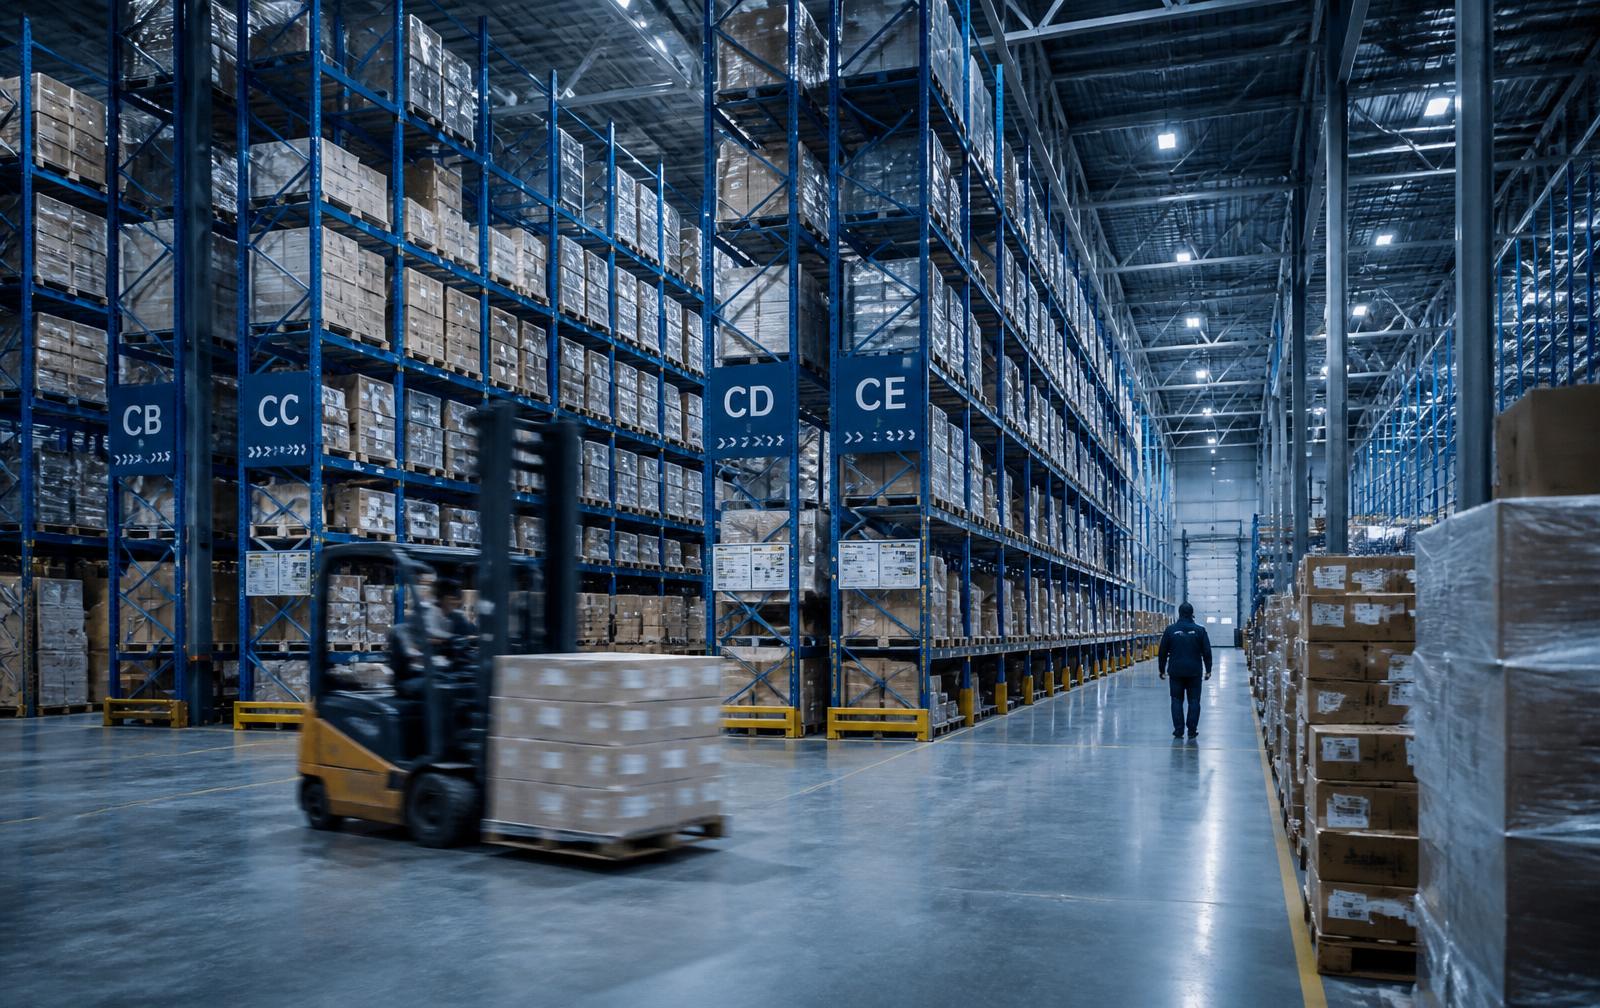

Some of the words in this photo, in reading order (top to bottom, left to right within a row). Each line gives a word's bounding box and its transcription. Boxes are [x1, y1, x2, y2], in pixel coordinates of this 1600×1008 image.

[723, 385, 774, 418] CD
[855, 376, 906, 411] CE
[123, 405, 162, 436] CB
[258, 394, 299, 427] CC
